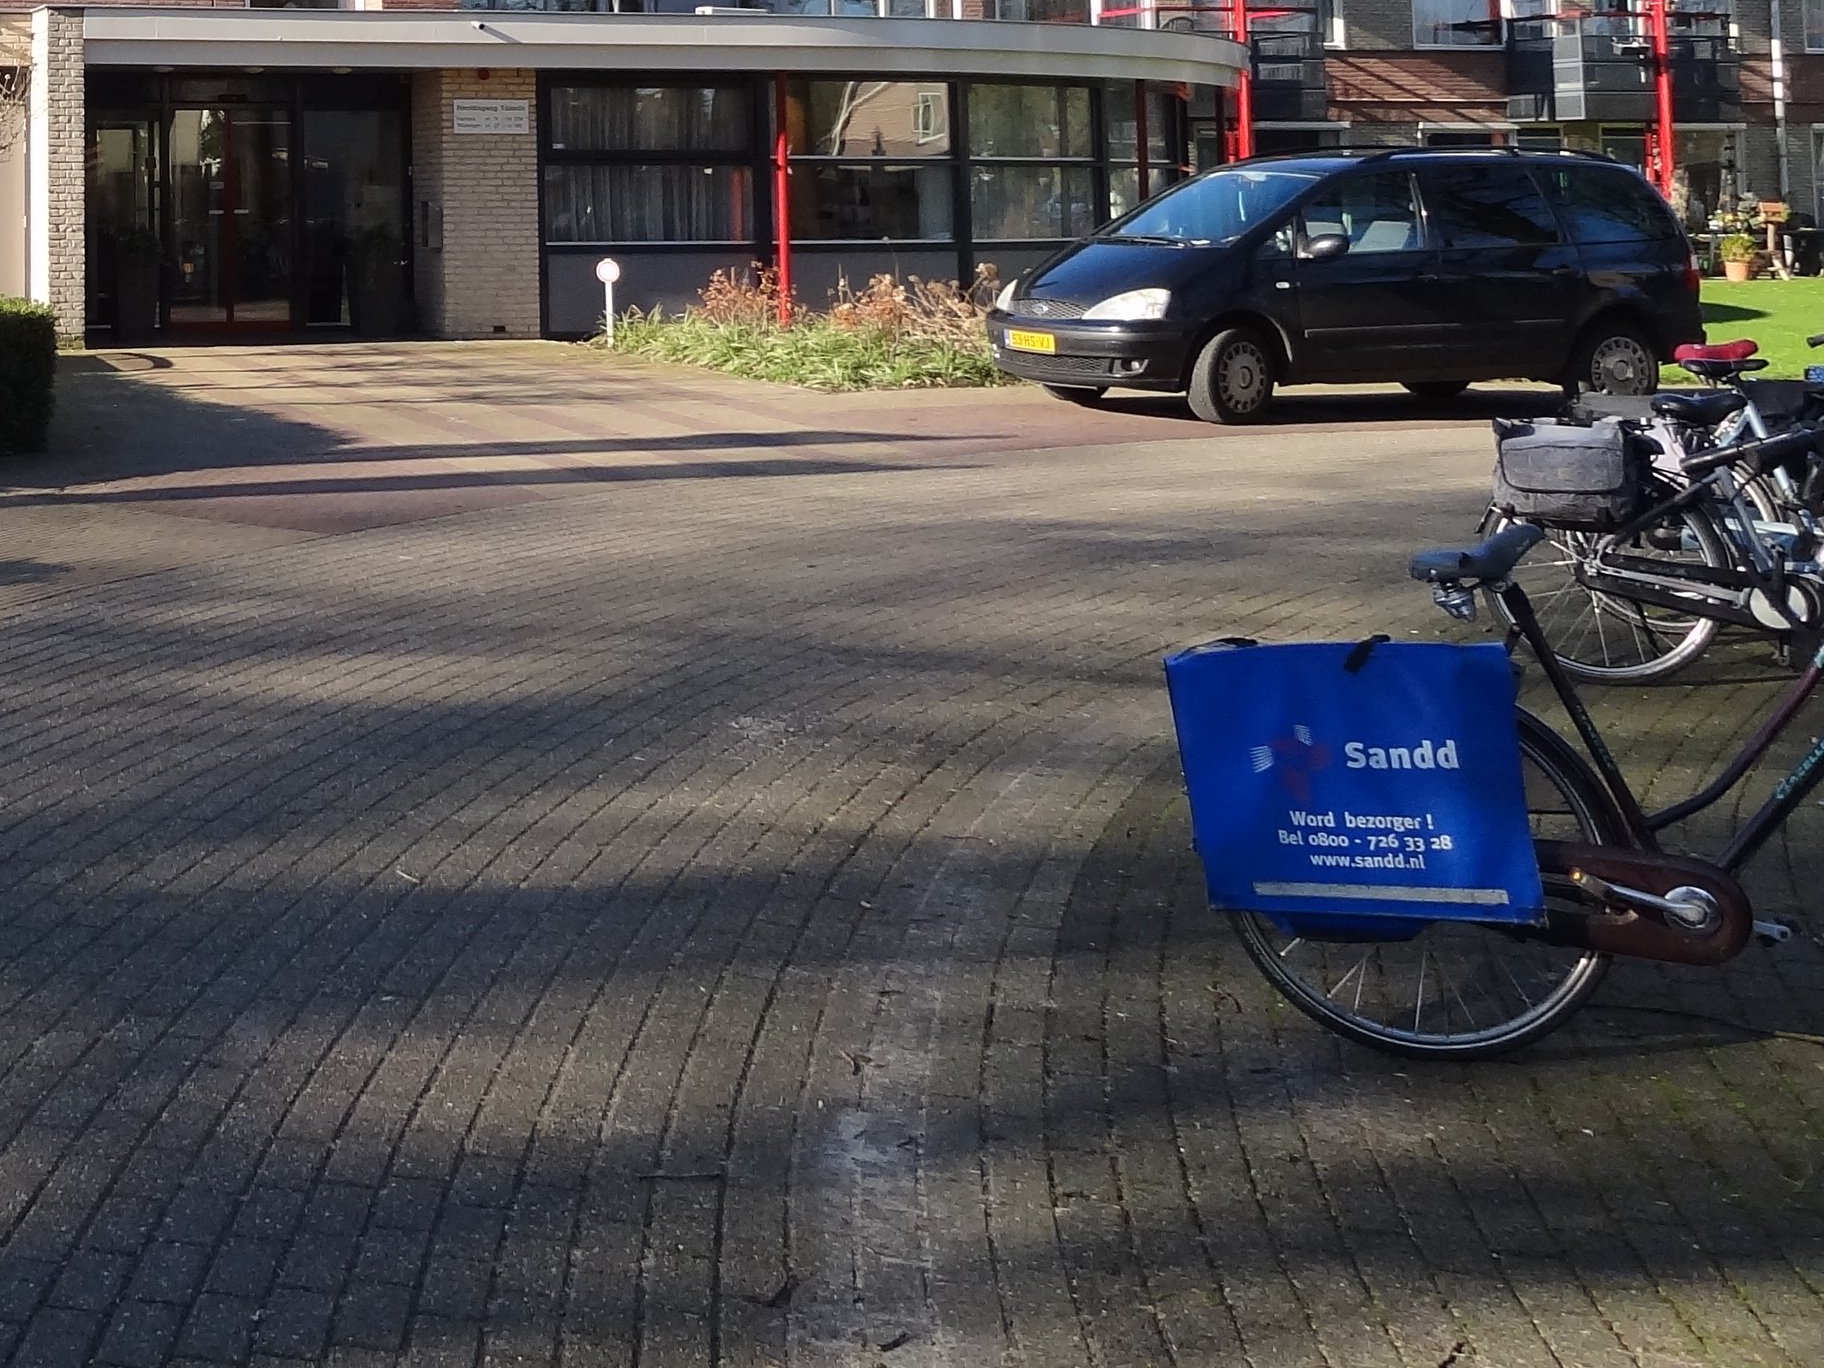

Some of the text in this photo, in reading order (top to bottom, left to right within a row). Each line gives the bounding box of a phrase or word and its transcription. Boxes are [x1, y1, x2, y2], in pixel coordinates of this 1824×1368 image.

[1345, 739, 1460, 770] Sandd
[1289, 810, 1335, 828] Word
[1344, 811, 1422, 832] bezorger
[1278, 830, 1304, 846] Bel
[1308, 833, 1349, 847] 0800
[1367, 834, 1399, 851] 726
[1404, 837, 1425, 852] 33
[1430, 835, 1453, 850] 28
[1309, 853, 1426, 869] www.sandd.nl
